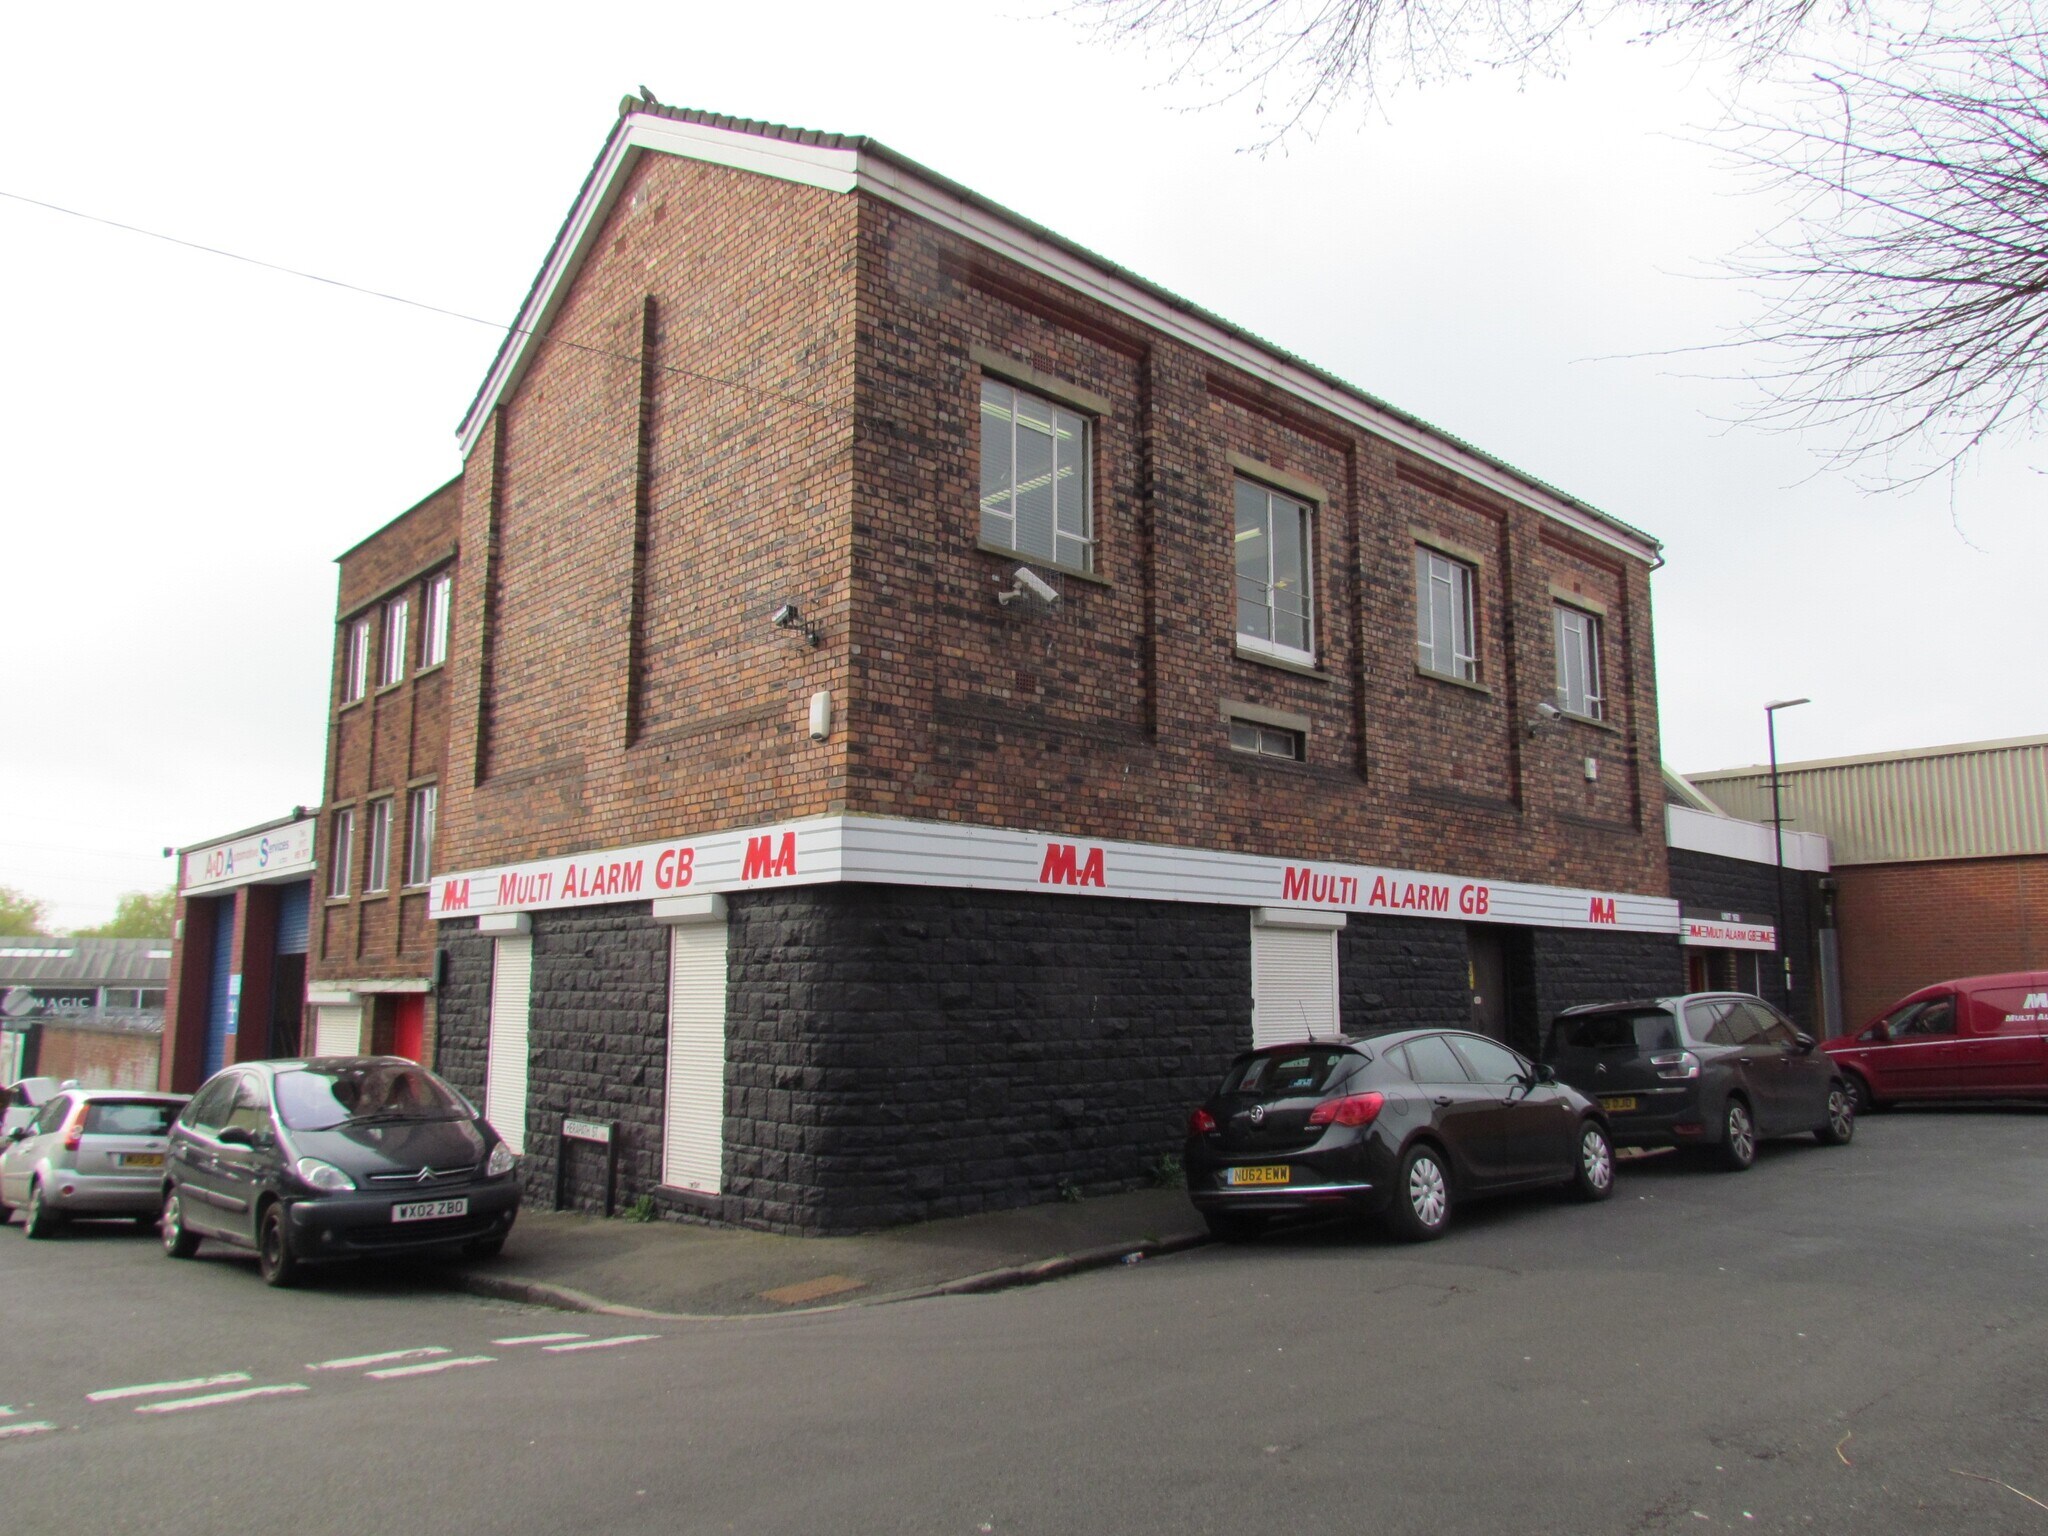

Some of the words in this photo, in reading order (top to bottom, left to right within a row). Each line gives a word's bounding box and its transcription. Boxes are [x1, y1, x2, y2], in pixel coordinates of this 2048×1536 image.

[497, 872, 553, 906] MULTI
[560, 859, 644, 899] ALARM
[655, 847, 695, 890] GB
[1282, 866, 1357, 905] MULTI
[1369, 875, 1449, 912] ALARM
[1459, 884, 1489, 915] GB
[1747, 930, 1757, 941] GB
[33, 997, 90, 1008] MAGIC
[2005, 1014, 2035, 1022] MULTI
[1234, 1168, 1263, 1182] NU62
[1265, 1167, 1287, 1180] EWW
[400, 1204, 434, 1218] WX02
